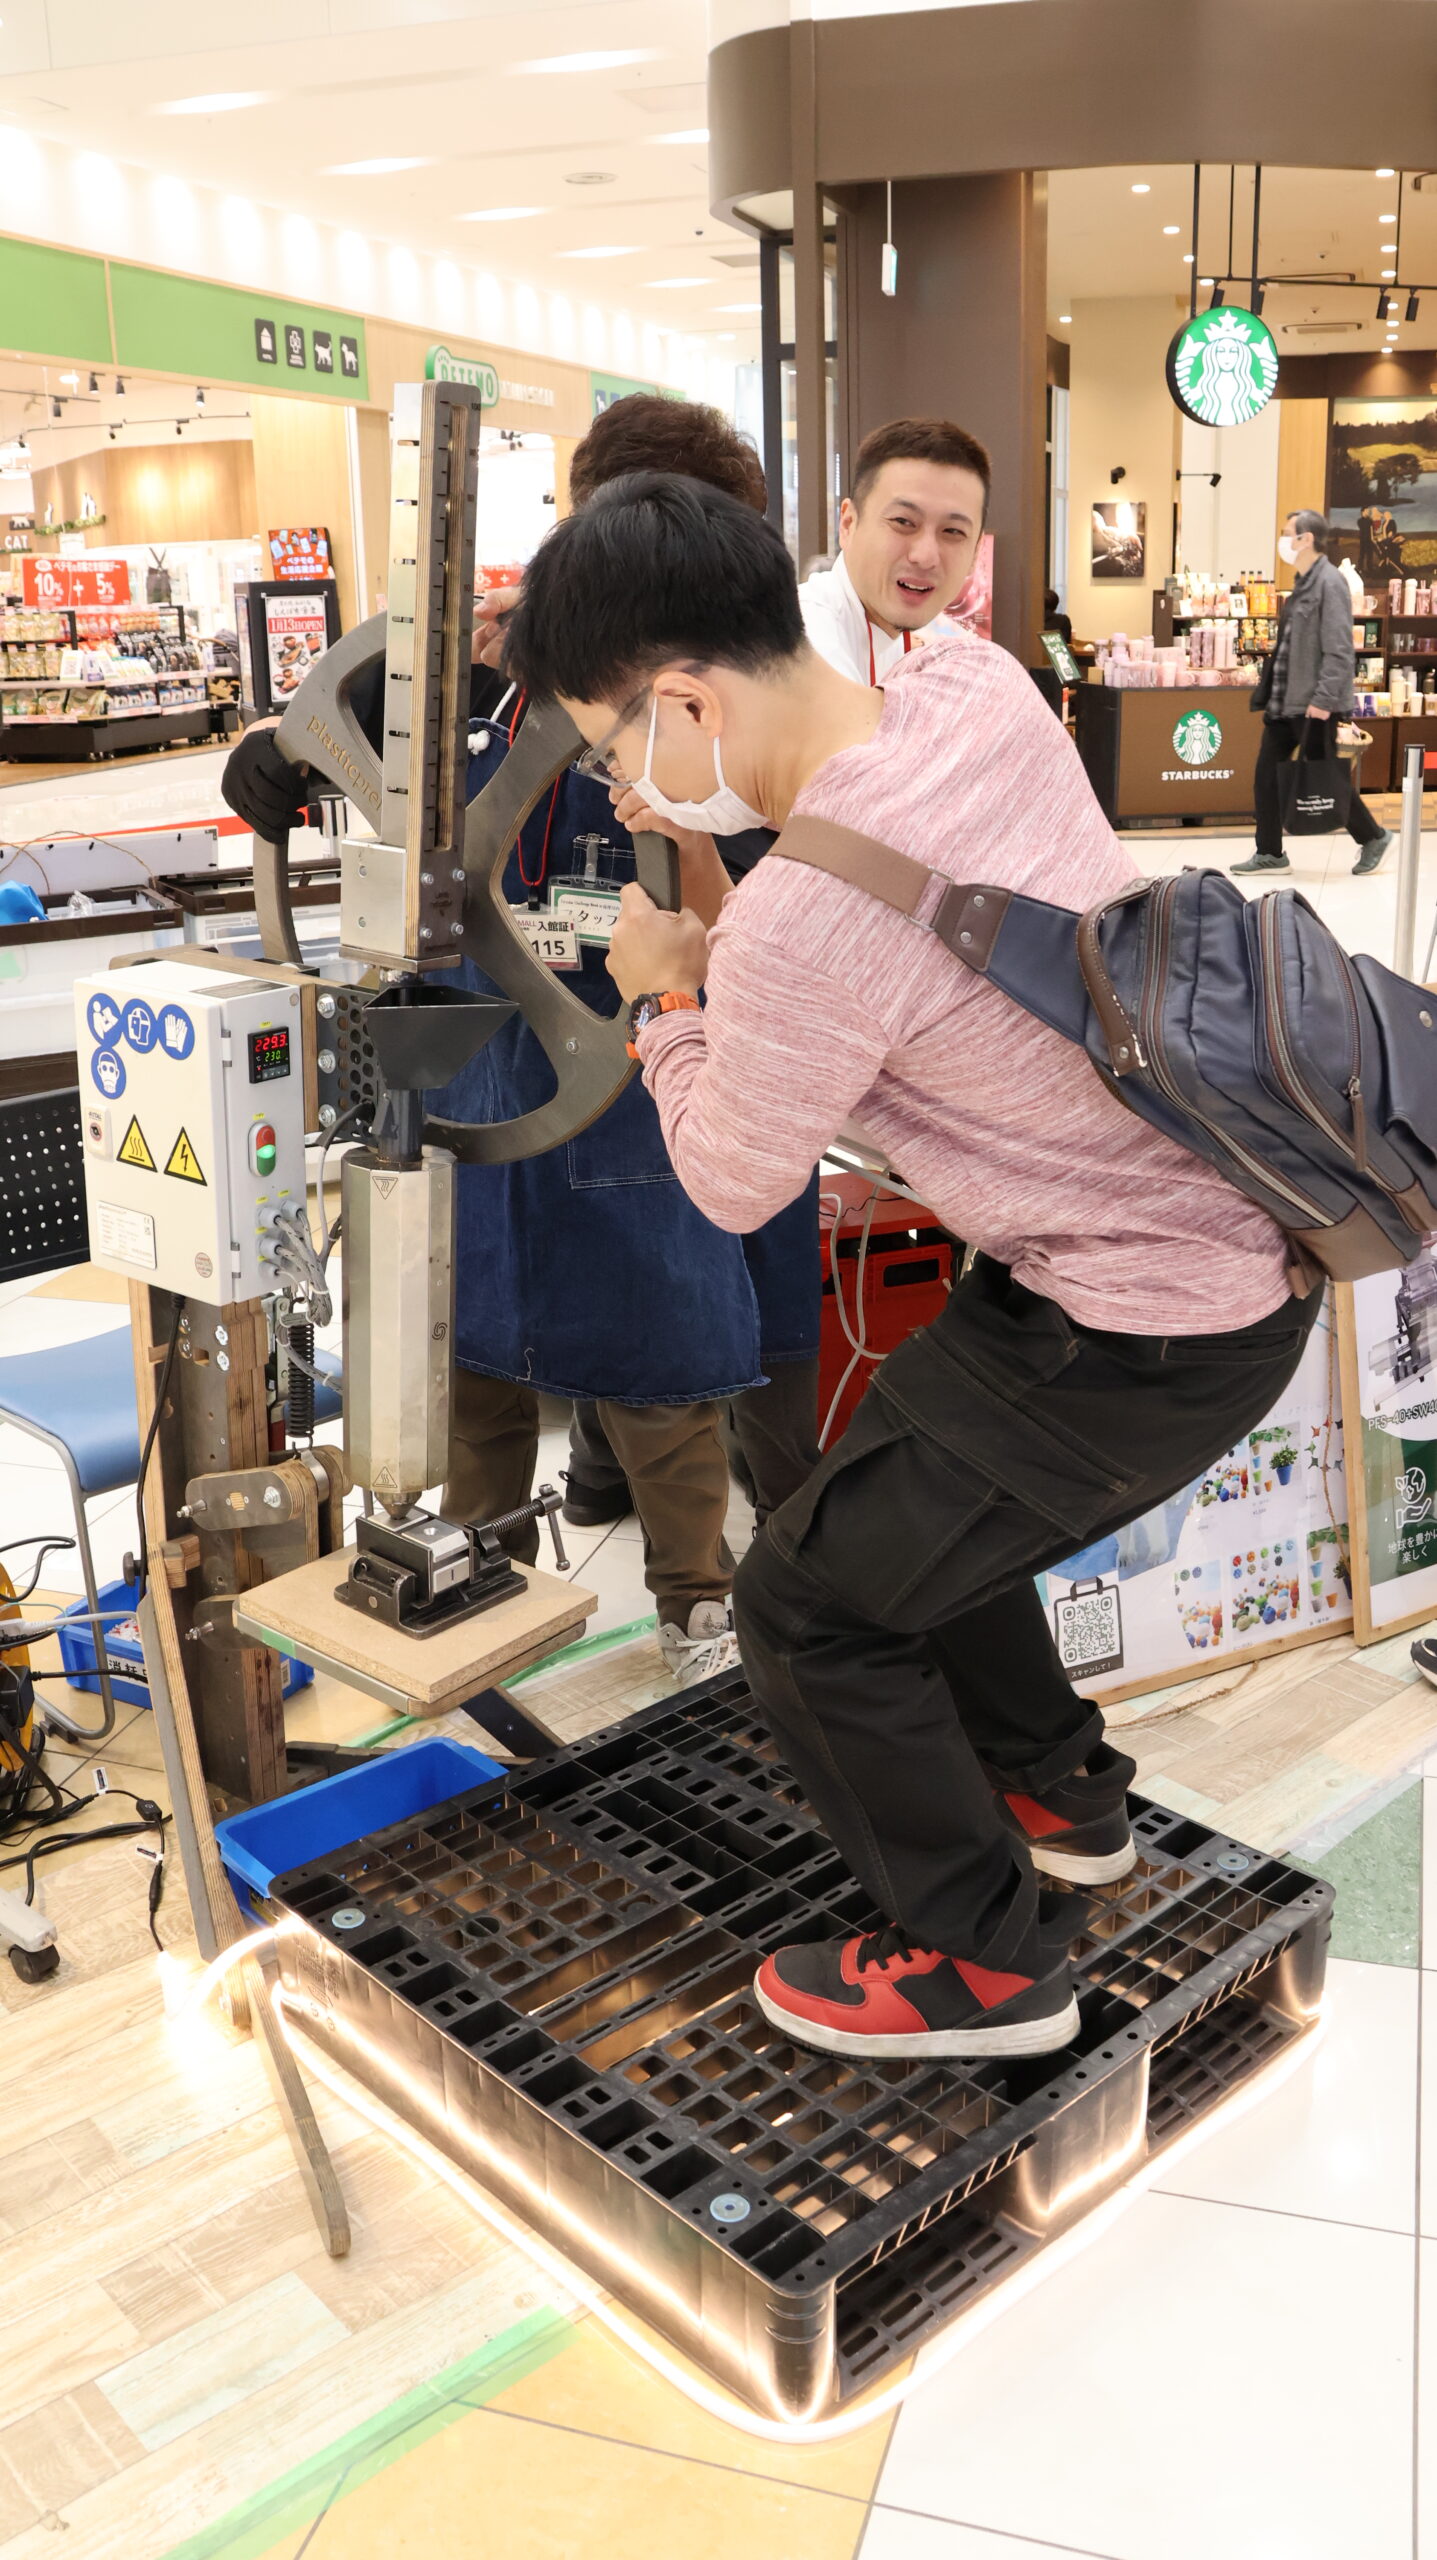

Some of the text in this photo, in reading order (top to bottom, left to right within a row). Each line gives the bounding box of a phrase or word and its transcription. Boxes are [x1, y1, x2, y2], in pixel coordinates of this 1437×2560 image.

[4, 535, 29, 550] CAT
[34, 573, 64, 596] 10%
[96, 573, 115, 595] 5%
[537, 921, 570, 932] 入館証
[1402, 1545, 1428, 1564] 楽しく
